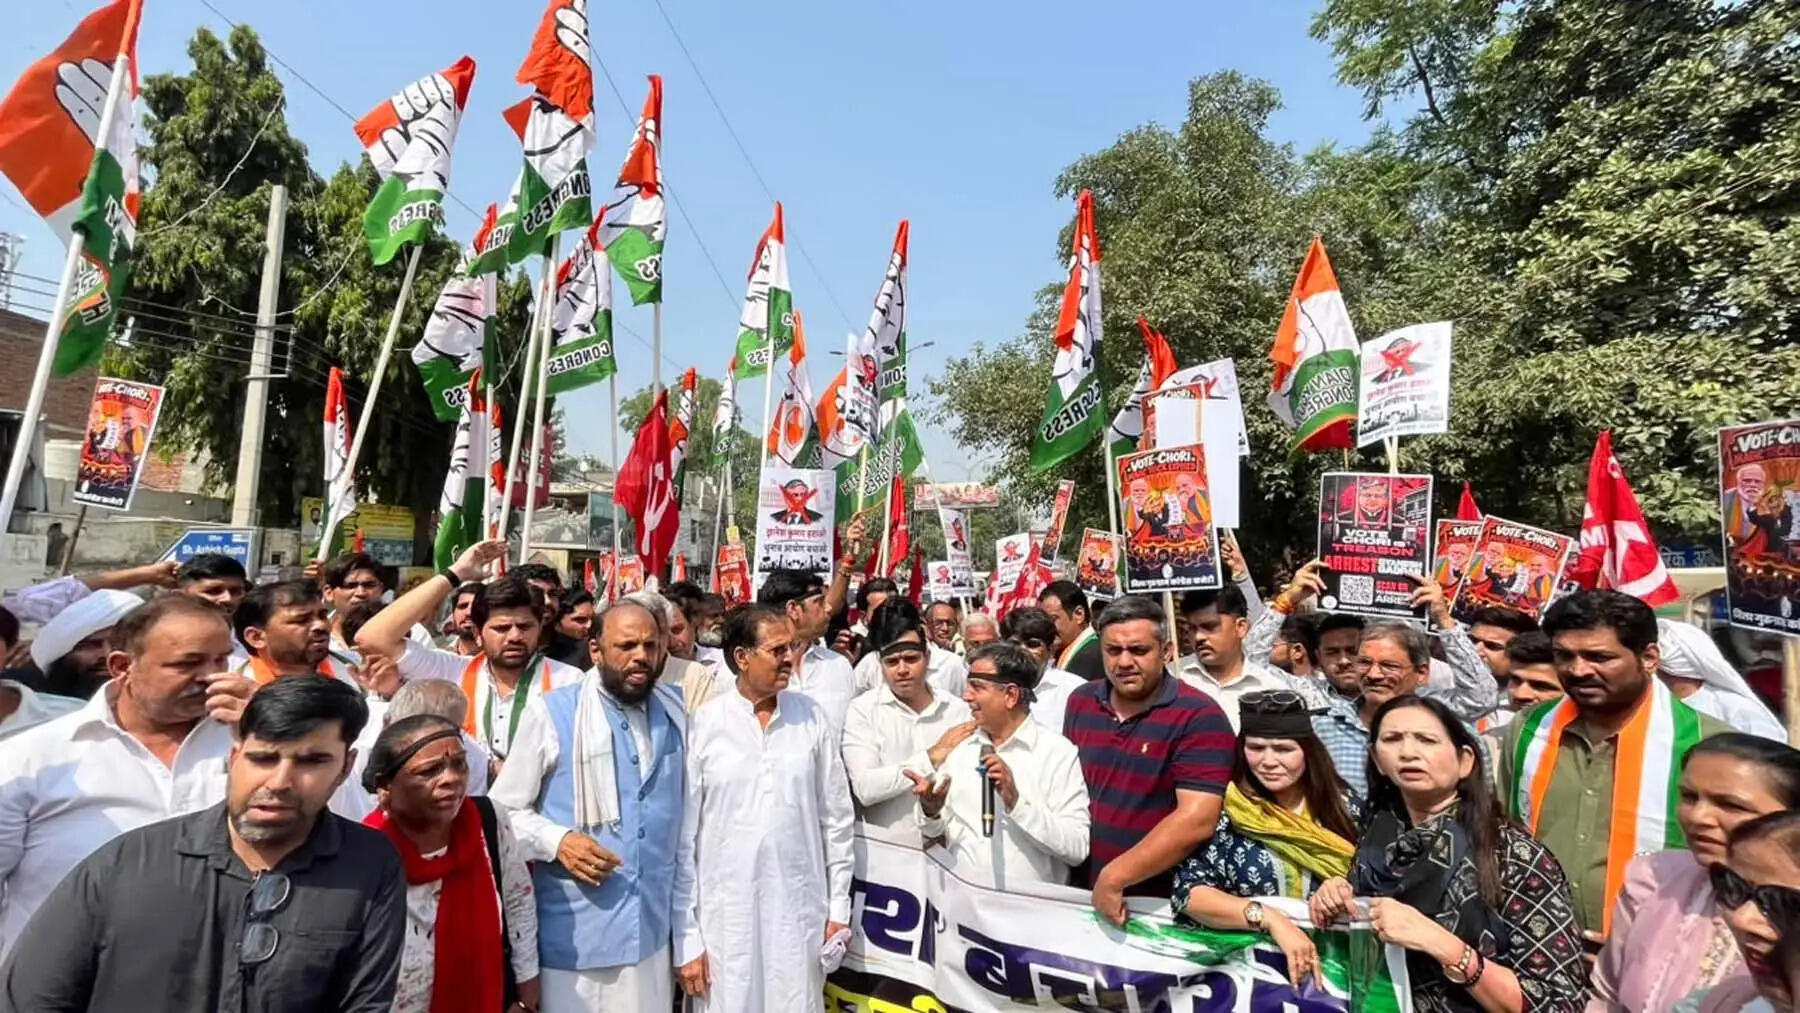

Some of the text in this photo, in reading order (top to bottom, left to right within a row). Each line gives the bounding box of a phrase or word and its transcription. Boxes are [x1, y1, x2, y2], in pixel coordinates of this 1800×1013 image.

[1345, 528, 1389, 538] VOTE
[1342, 536, 1391, 546] CHORI
[1332, 543, 1415, 556] TREASON
[1325, 555, 1377, 573] ARREST
